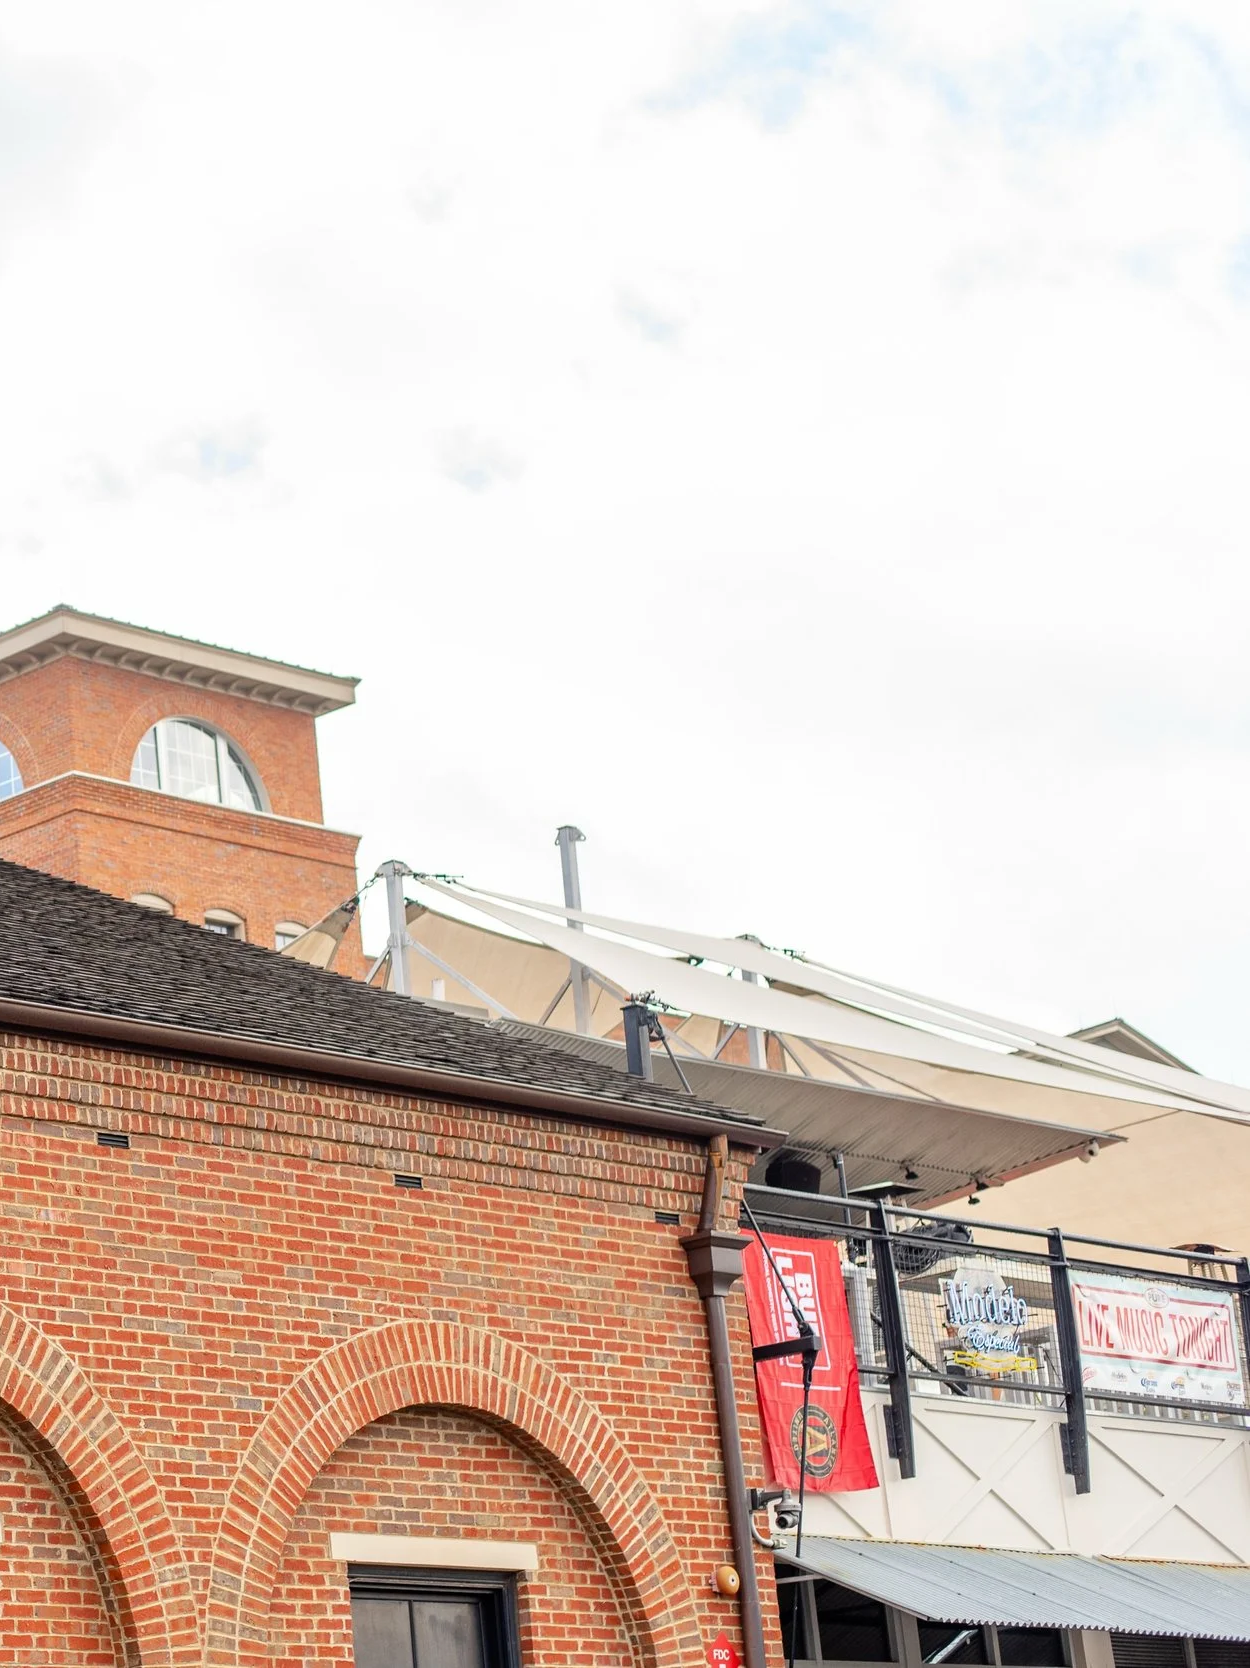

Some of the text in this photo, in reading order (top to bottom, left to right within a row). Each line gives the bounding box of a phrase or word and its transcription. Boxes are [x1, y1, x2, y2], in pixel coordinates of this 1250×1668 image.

[776, 1256, 802, 1345] LIGH
[795, 1273, 820, 1340] BU
[946, 1279, 1028, 1325] Modelo
[967, 1326, 1020, 1354] Especial
[1078, 1301, 1230, 1363] LIVE MUSIC TONIGHT
[824, 1417, 837, 1467] ATLANTA
[713, 1649, 730, 1661] FDC
